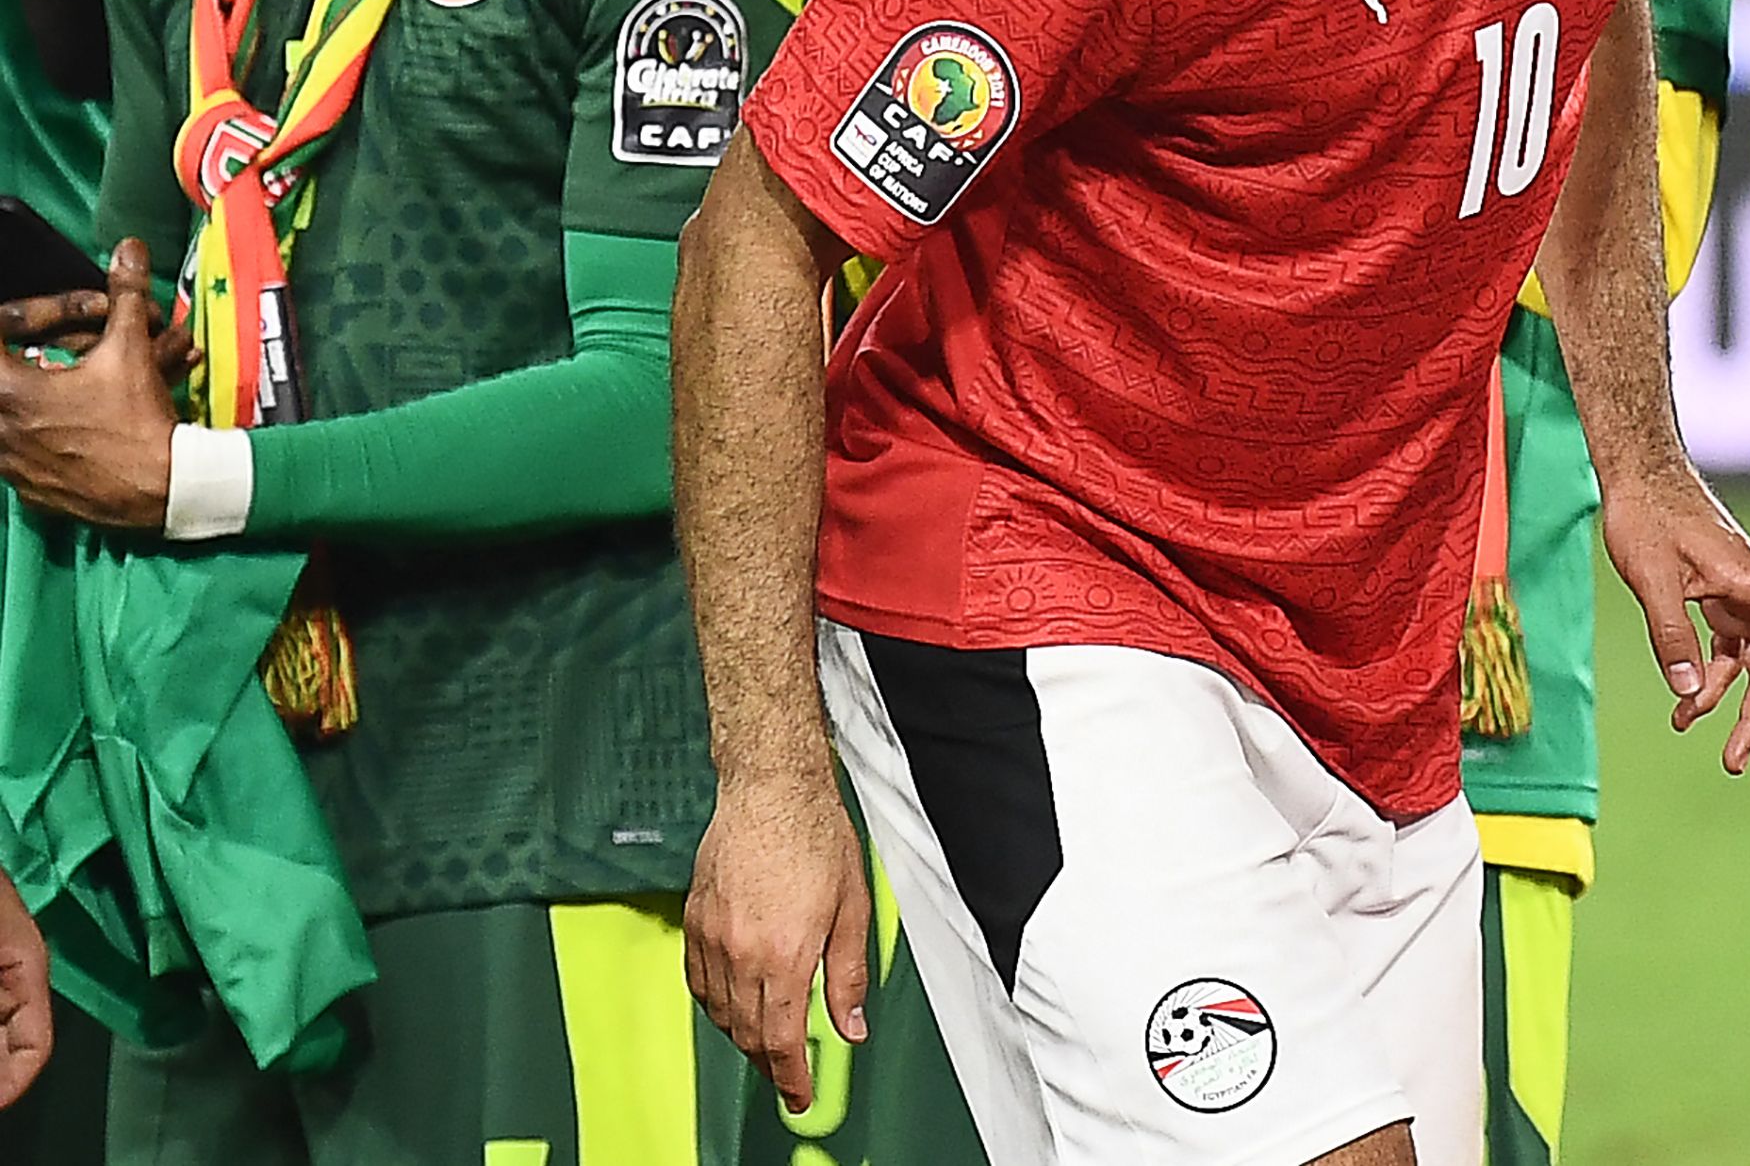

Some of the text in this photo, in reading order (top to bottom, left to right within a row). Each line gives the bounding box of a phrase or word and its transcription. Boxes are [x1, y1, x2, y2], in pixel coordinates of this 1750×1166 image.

[920, 36, 996, 73] CAMEROON
[1458, 2, 1560, 220] 10
[640, 123, 721, 149] CAF
[883, 102, 954, 162] CAF
[877, 152, 902, 174] CUP
[885, 140, 925, 177] AFRICA
[882, 174, 929, 213] NATIONS
